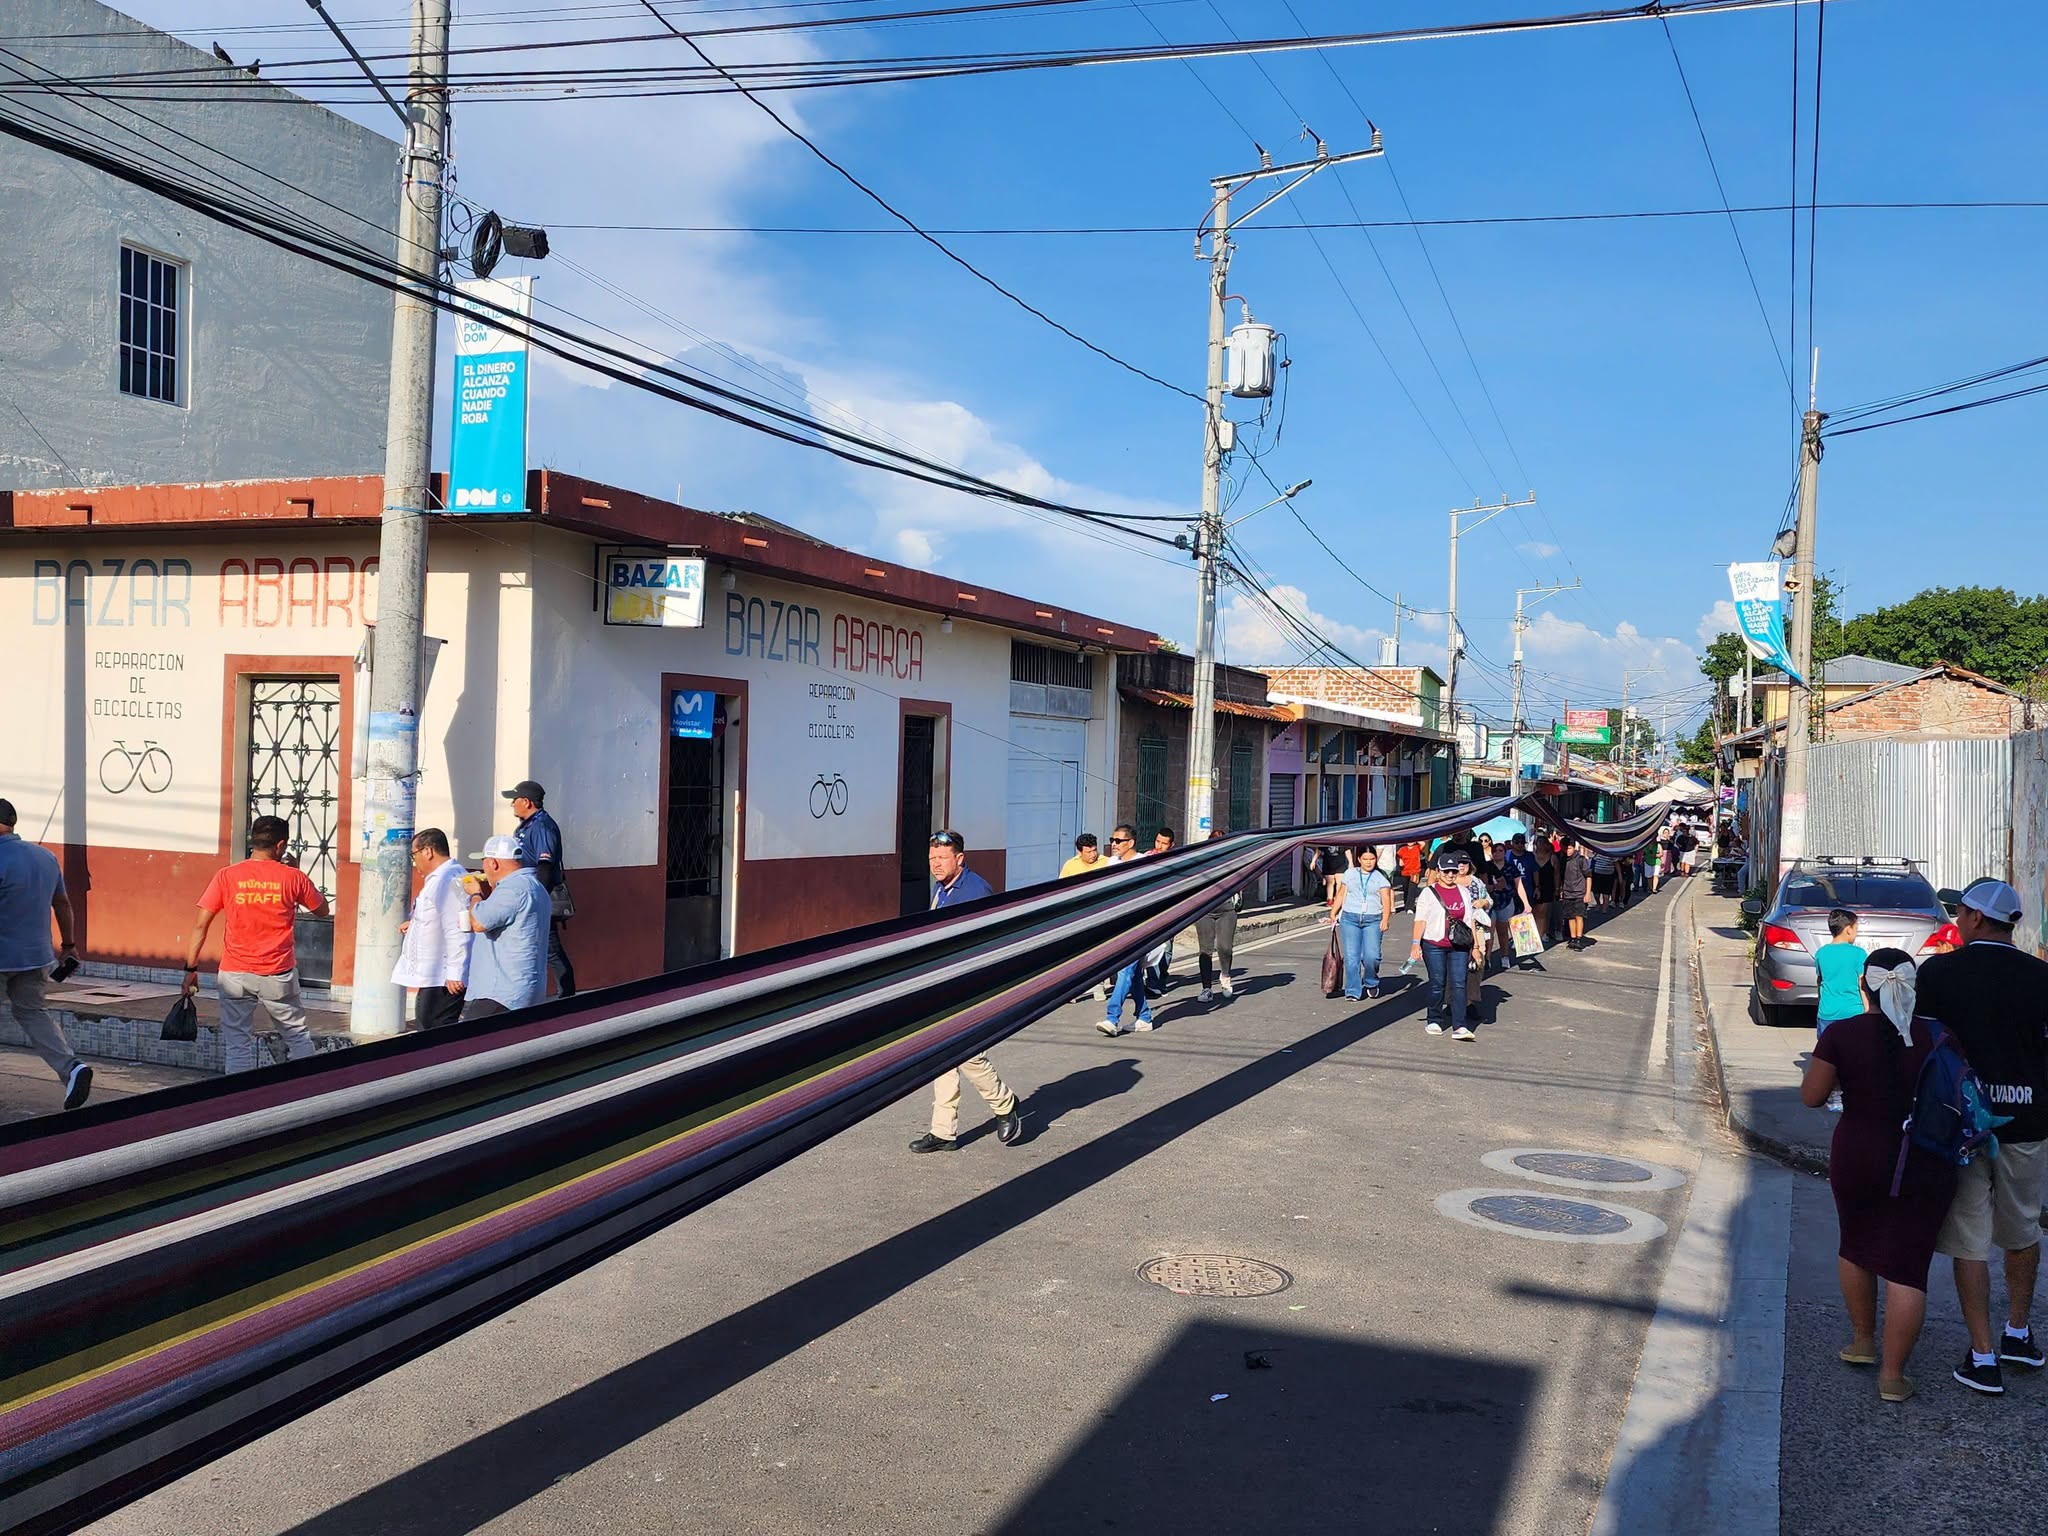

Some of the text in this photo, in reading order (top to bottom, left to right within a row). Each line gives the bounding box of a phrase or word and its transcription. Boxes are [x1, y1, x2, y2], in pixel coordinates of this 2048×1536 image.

[464, 333, 487, 343] DOM
[463, 361, 516, 376] EL DINERO
[462, 375, 510, 388] ALCANZA
[462, 386, 506, 400] CUANDO
[461, 400, 493, 412] NADIE
[461, 412, 489, 425] ROBA
[455, 487, 498, 507] DOM
[613, 563, 700, 588] BAZAR
[32, 556, 380, 628] BAZAR ABARC
[725, 592, 923, 682] BAZAR ABARCA
[95, 652, 184, 671] REPARACION
[130, 676, 146, 694] DE
[809, 683, 856, 701] REPARACION
[94, 699, 182, 719] BICICLETAS
[828, 704, 837, 719] DE
[809, 723, 855, 739] BICICLETAS
[1986, 1084, 2033, 1104] LVADOR
